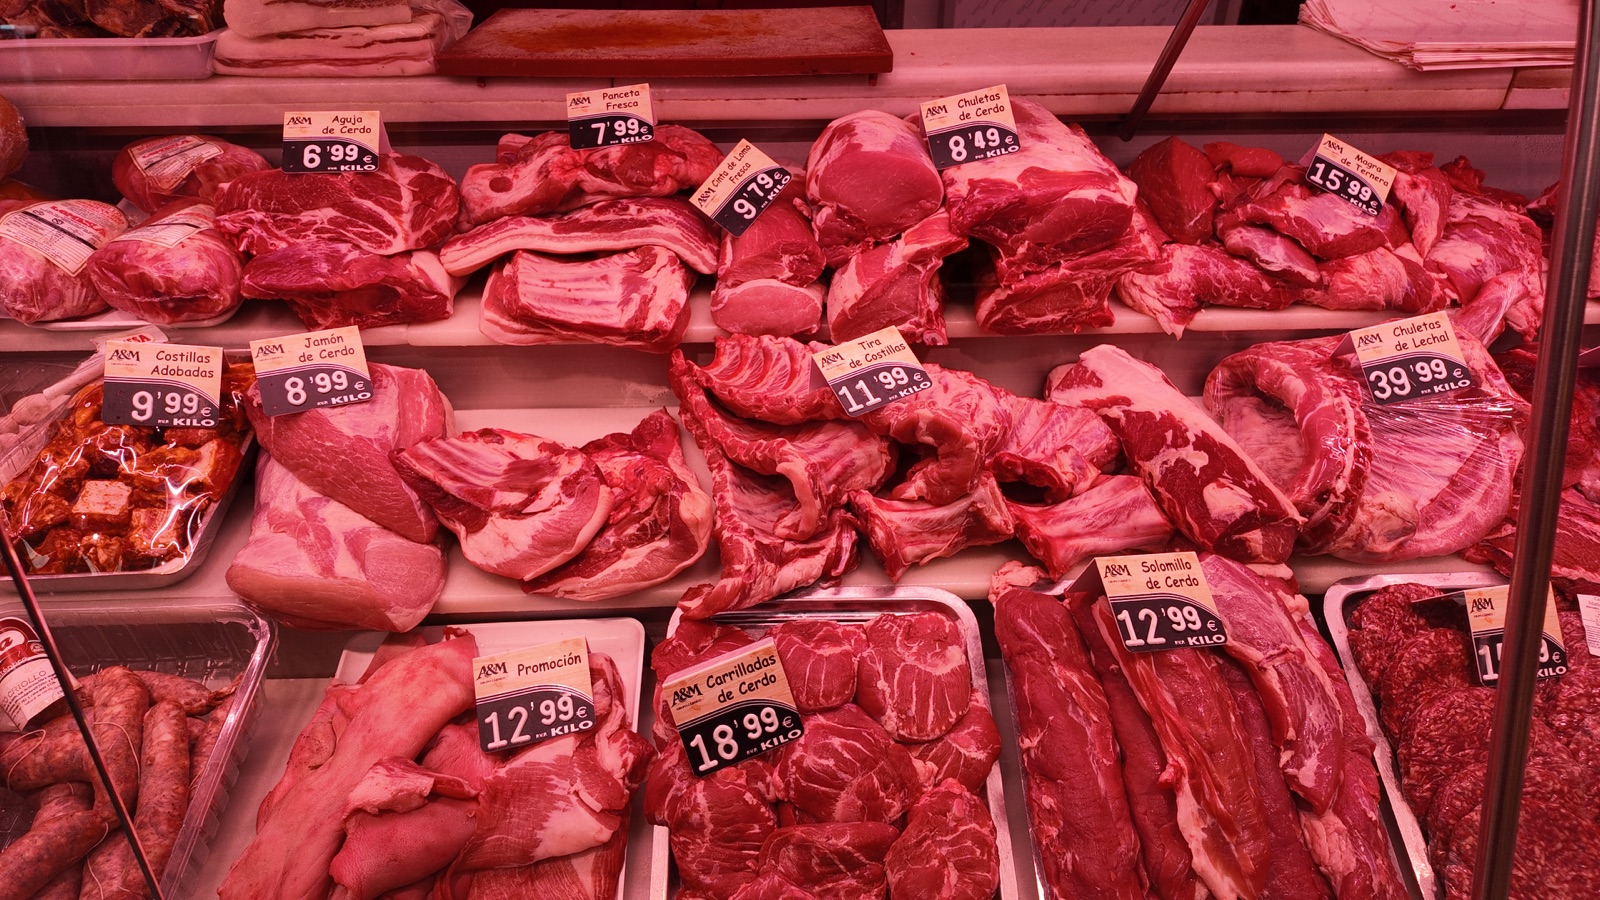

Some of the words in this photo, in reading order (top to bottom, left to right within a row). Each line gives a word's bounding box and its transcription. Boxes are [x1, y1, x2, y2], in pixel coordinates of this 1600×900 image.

[569, 96, 591, 107] A&M
[602, 91, 640, 100] Panceta
[957, 92, 1001, 108] Chuletas
[606, 101, 638, 110] Fresca
[925, 104, 948, 118] A&M
[959, 111, 973, 121] de
[976, 105, 1005, 117] Cerdo
[287, 117, 312, 125] A&M
[332, 116, 363, 125] Aguja
[322, 126, 335, 134] de
[338, 126, 371, 134] Cerdo
[621, 135, 652, 143] KILO
[1323, 140, 1343, 153] A&M
[986, 145, 1019, 158] KILO
[712, 172, 728, 188] Cinta
[728, 160, 737, 171] de
[733, 145, 751, 162] Lomo
[1355, 154, 1382, 173] Magra
[729, 162, 751, 184] Fresca
[1341, 157, 1351, 167] de
[1355, 164, 1389, 186] Ternera
[768, 176, 790, 200] KILO
[697, 188, 715, 207] A&M
[1350, 198, 1378, 216] KILO
[1393, 320, 1441, 337] Chuletas
[304, 334, 344, 349] Jamón
[858, 337, 881, 350] Tira
[1357, 333, 1383, 349] A&M
[1395, 340, 1409, 351] de
[1412, 331, 1450, 348] Lechal
[108, 349, 140, 362] A&M
[156, 351, 210, 363] Costillas
[255, 343, 285, 358] A&M
[298, 352, 316, 362] de
[318, 346, 355, 360] Cerdo
[849, 357, 863, 369] de
[864, 342, 907, 365] Costillas
[821, 352, 844, 368] A&M
[151, 365, 214, 378] Adobadas
[899, 381, 931, 398] KILO
[1433, 379, 1471, 393] KILO
[331, 392, 371, 404] KILO
[173, 418, 214, 426] KILO
[1104, 564, 1131, 579] A&M
[1141, 561, 1191, 573] Solomillo
[1146, 577, 1163, 590] de
[1165, 575, 1199, 589] Cerdo
[1470, 598, 1495, 613] A&M
[1187, 634, 1225, 646] KILO
[476, 662, 508, 681] A&M
[517, 653, 581, 676] Promoción
[706, 655, 776, 689] Carrilladas
[1537, 666, 1567, 678] KILO
[671, 683, 704, 708] A&M
[717, 690, 735, 703] de
[738, 674, 777, 695] Cerdo
[550, 721, 593, 736] KILO
[760, 728, 802, 750] KILO
